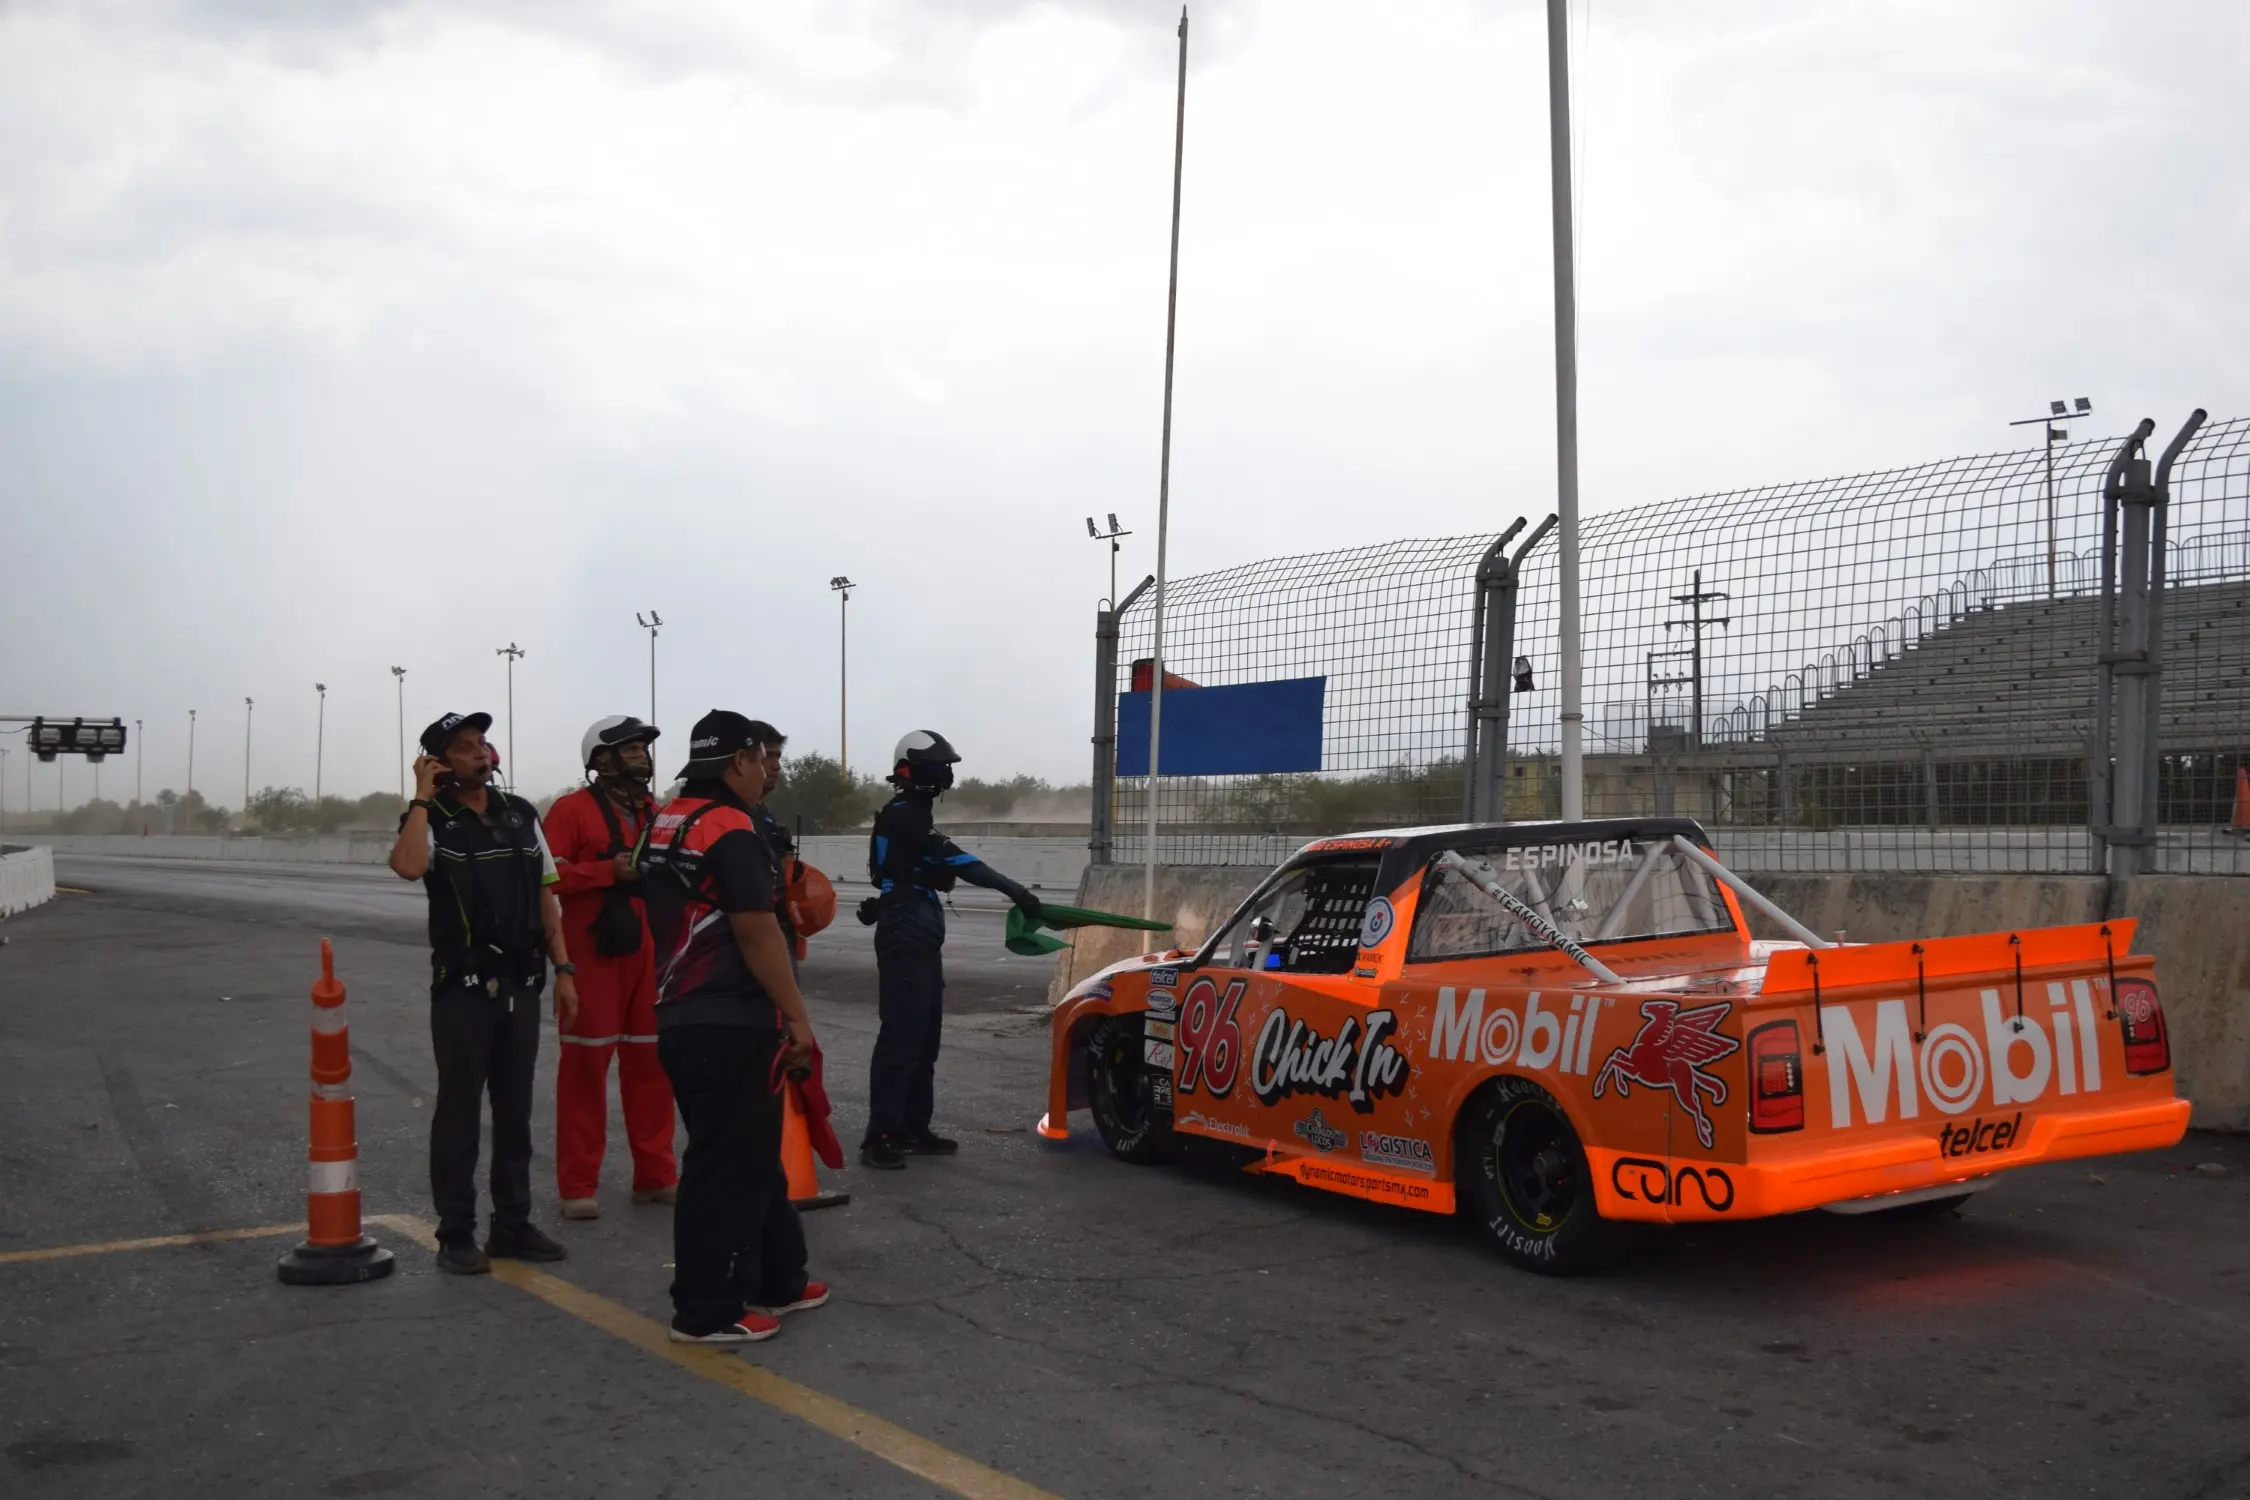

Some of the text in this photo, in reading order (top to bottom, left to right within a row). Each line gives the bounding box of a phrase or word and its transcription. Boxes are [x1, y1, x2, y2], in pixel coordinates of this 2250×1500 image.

[1505, 839, 1634, 871] ESPINOSA
[1152, 969, 1176, 985] telcel
[2124, 990, 2150, 1024] 96
[1180, 977, 1247, 1096] 96
[1429, 985, 1601, 1075] Mobil
[1252, 1007, 1404, 1102] Chick In
[1820, 979, 2102, 1129] Mobil
[1208, 1117, 1250, 1138] Electrolit
[1940, 1112, 2022, 1159] telcel
[1300, 1162, 1429, 1200] dynamicmotorsportsmx.com
